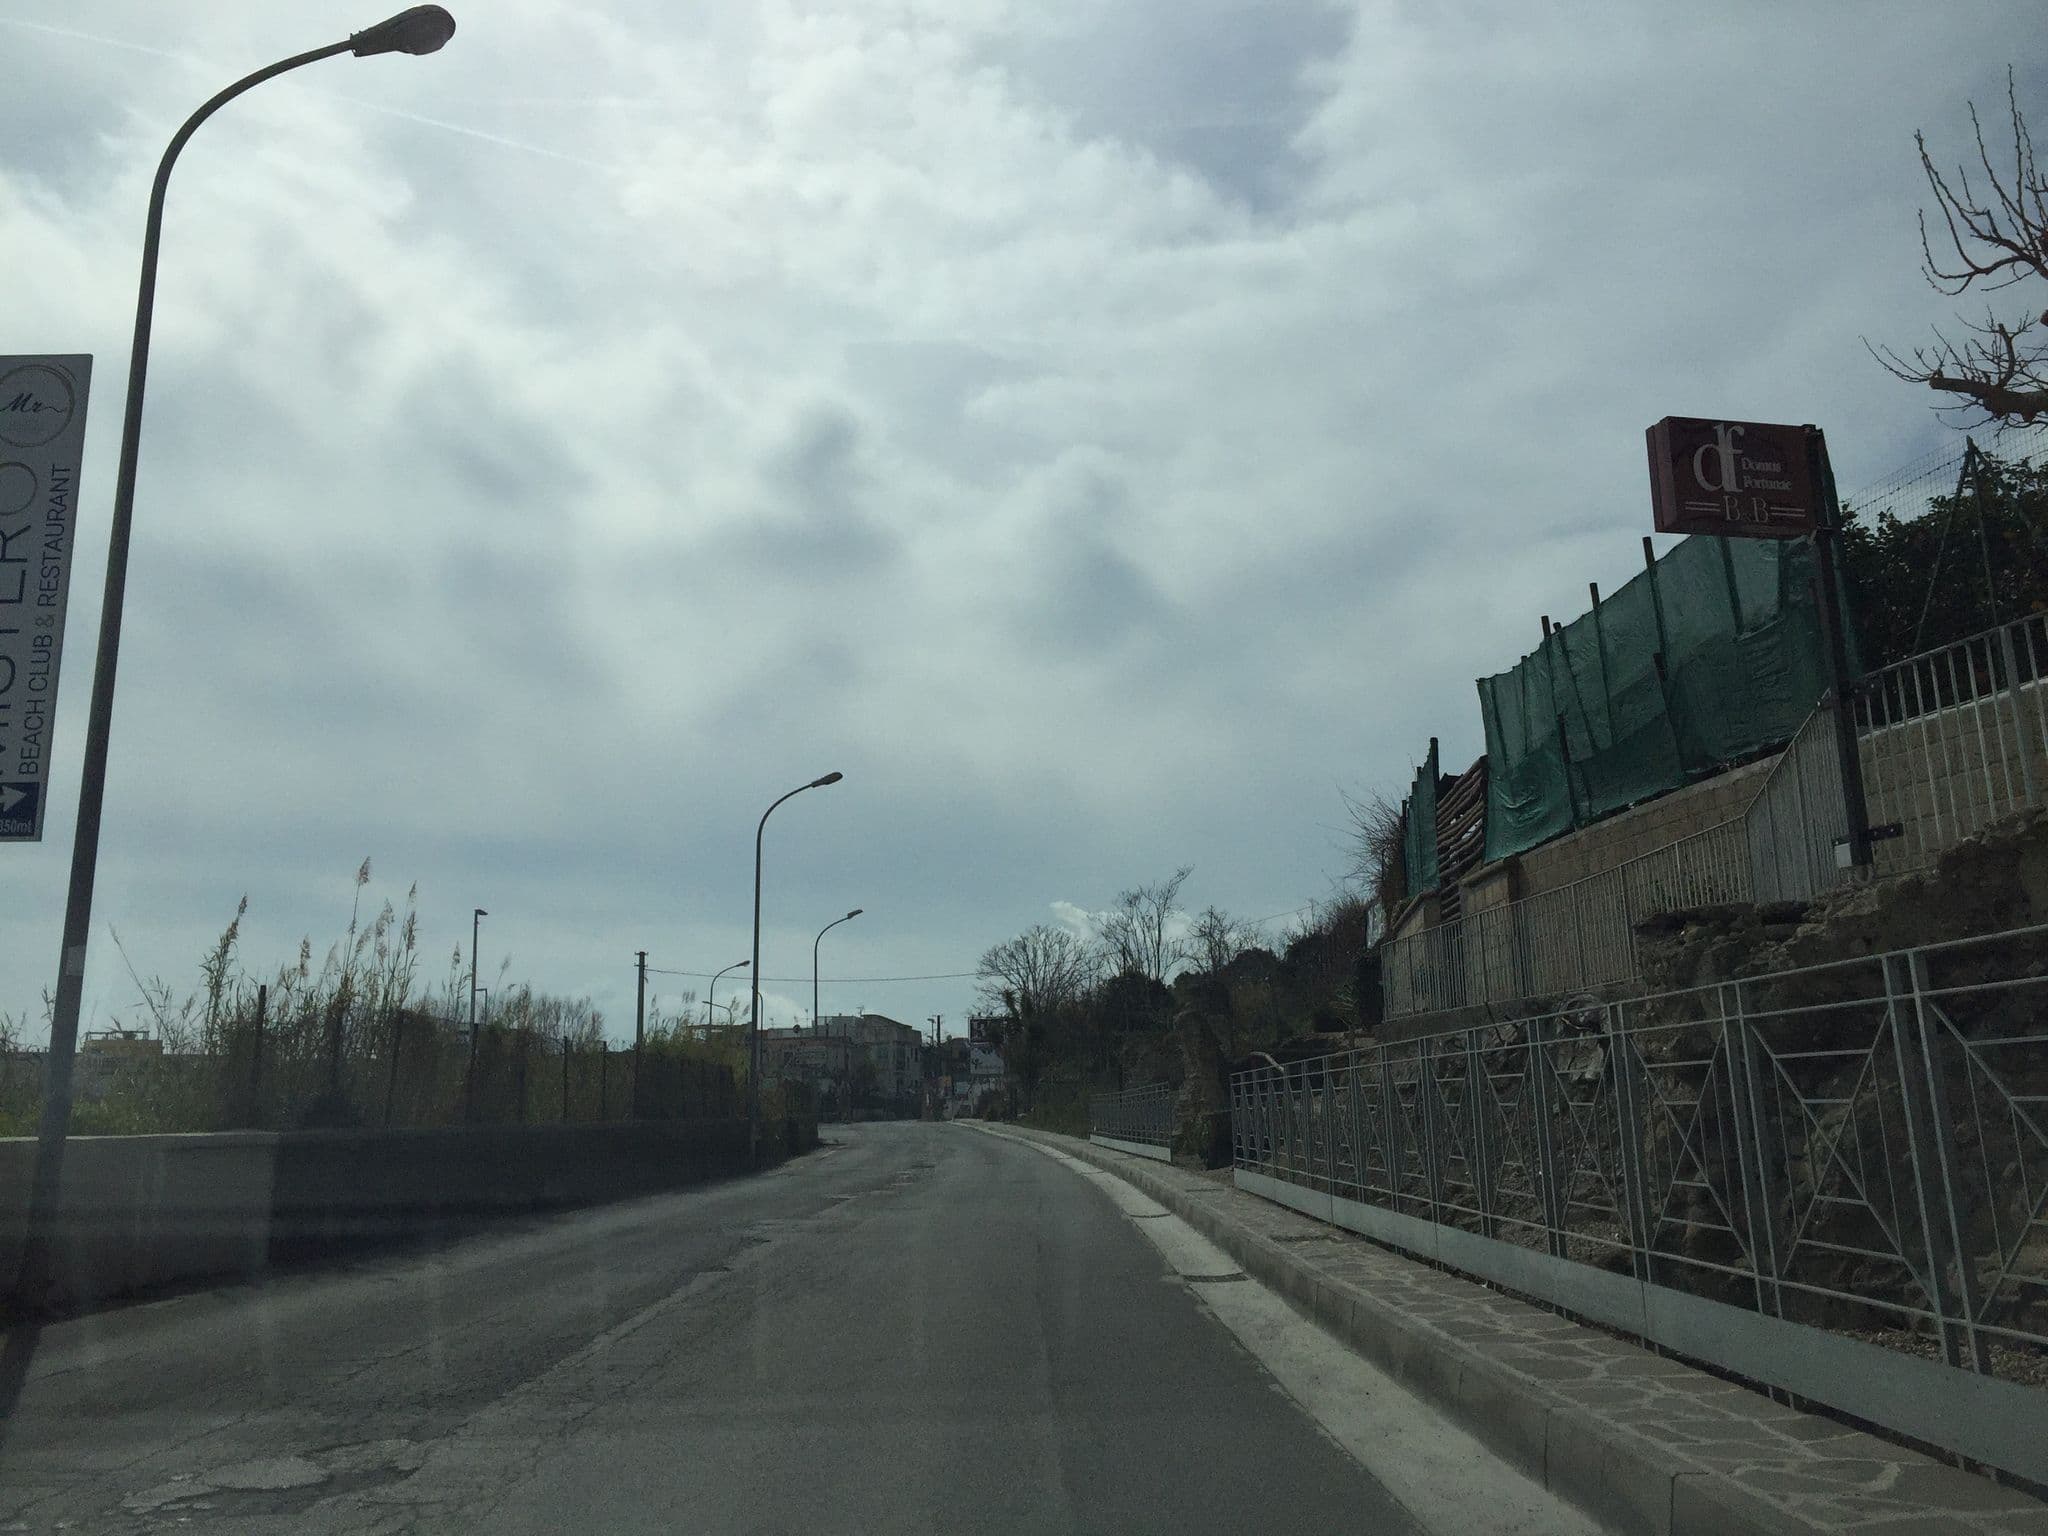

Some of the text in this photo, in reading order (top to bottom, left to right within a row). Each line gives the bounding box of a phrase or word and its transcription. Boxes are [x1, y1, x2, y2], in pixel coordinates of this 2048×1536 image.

[1741, 457, 1782, 473] Domus
[37, 464, 71, 607] RESTAURANT
[35, 614, 55, 629] &
[28, 634, 53, 692] CLUB
[18, 699, 46, 775] BEACH
